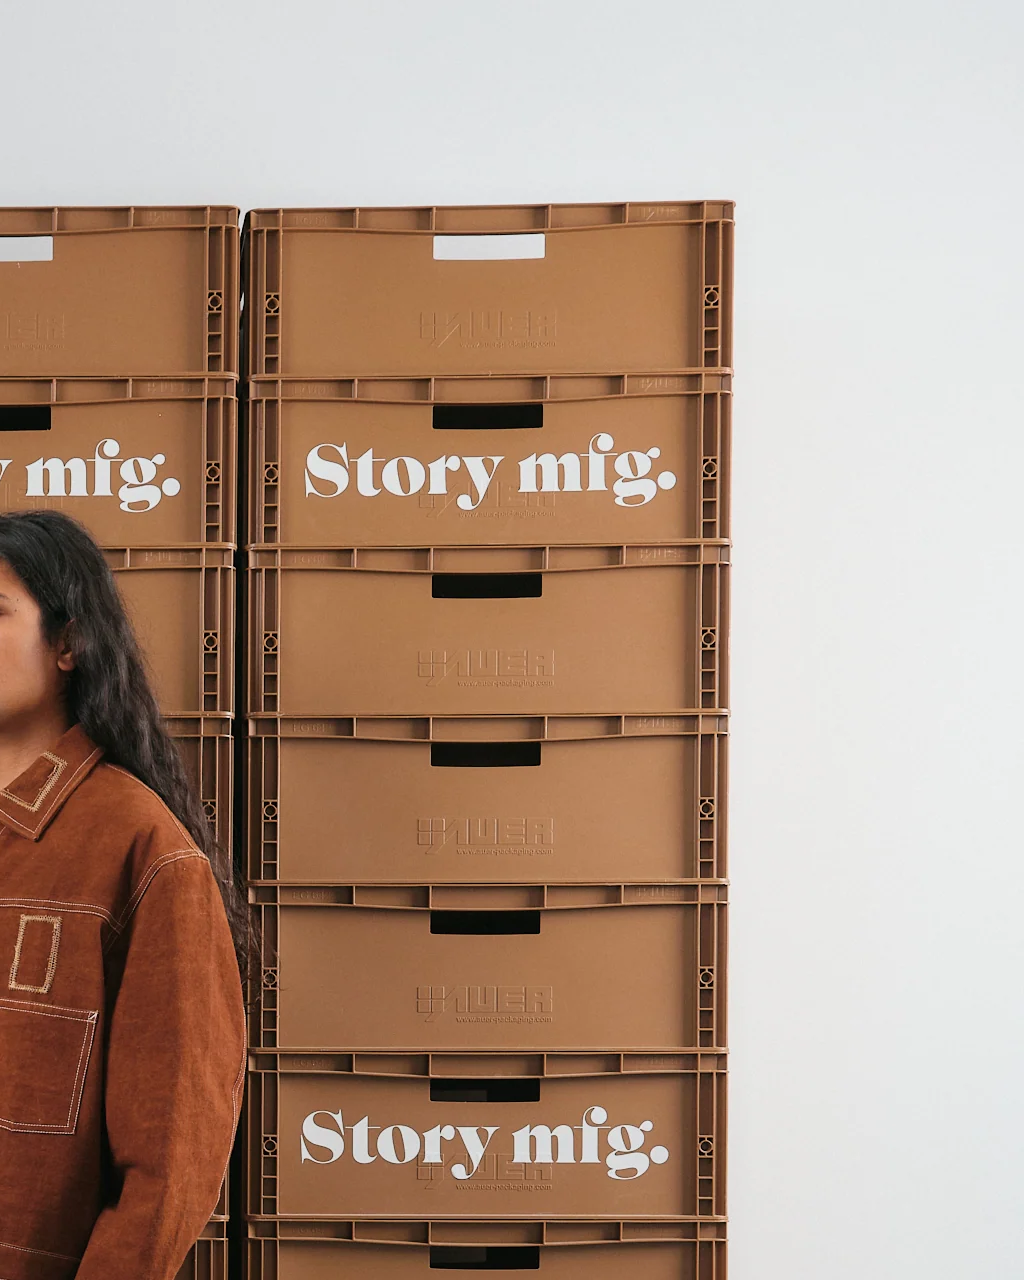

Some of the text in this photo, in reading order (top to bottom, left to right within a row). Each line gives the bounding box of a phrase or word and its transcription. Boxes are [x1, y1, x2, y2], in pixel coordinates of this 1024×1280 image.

[25, 438, 181, 513] mfg.
[304, 432, 677, 511] Story mfg.
[300, 1106, 669, 1180] Story mfg.
